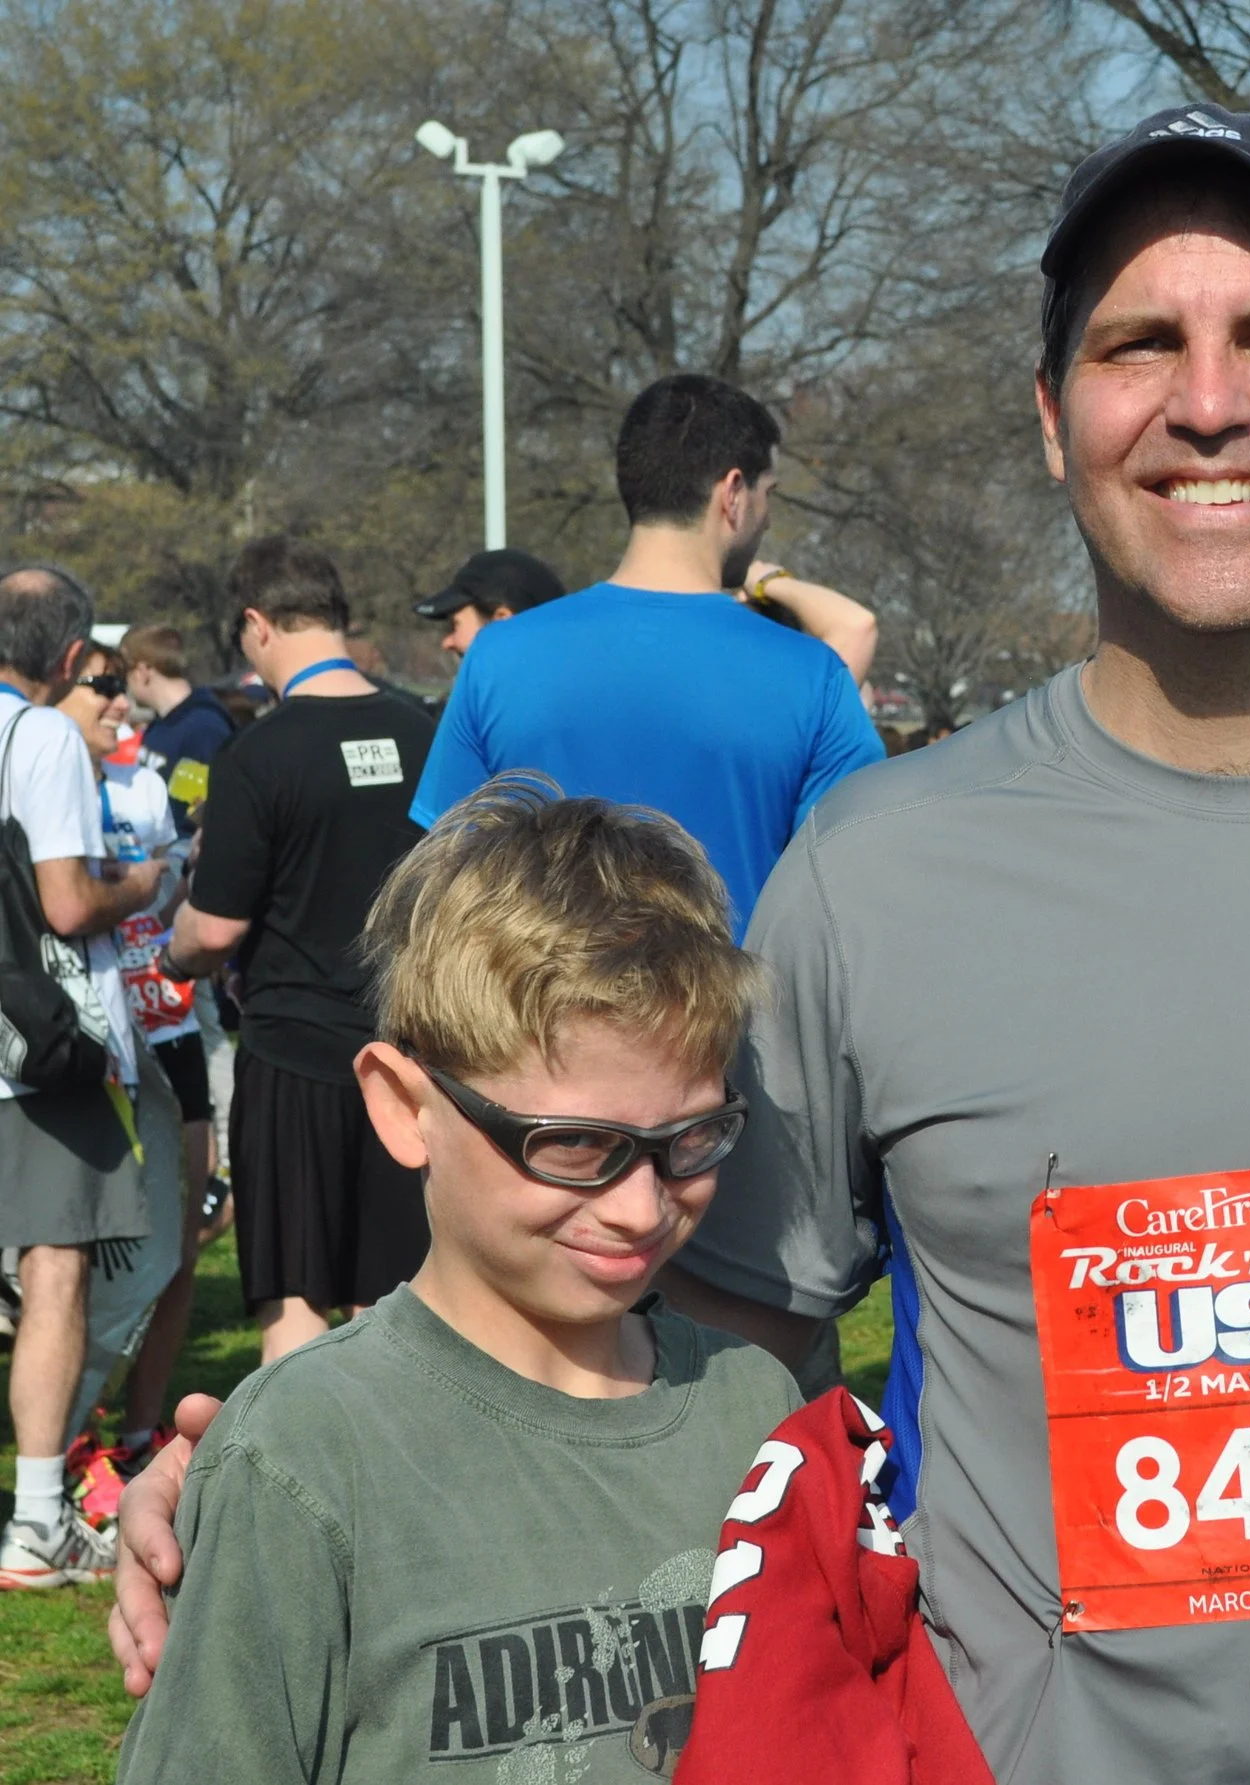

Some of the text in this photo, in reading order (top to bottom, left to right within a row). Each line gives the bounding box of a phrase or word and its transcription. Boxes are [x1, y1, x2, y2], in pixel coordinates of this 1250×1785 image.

[1123, 1241, 1197, 1257] INAUGURAL
[1059, 1242, 1241, 1289] Rock
[1145, 1373, 1192, 1402] 1/2
